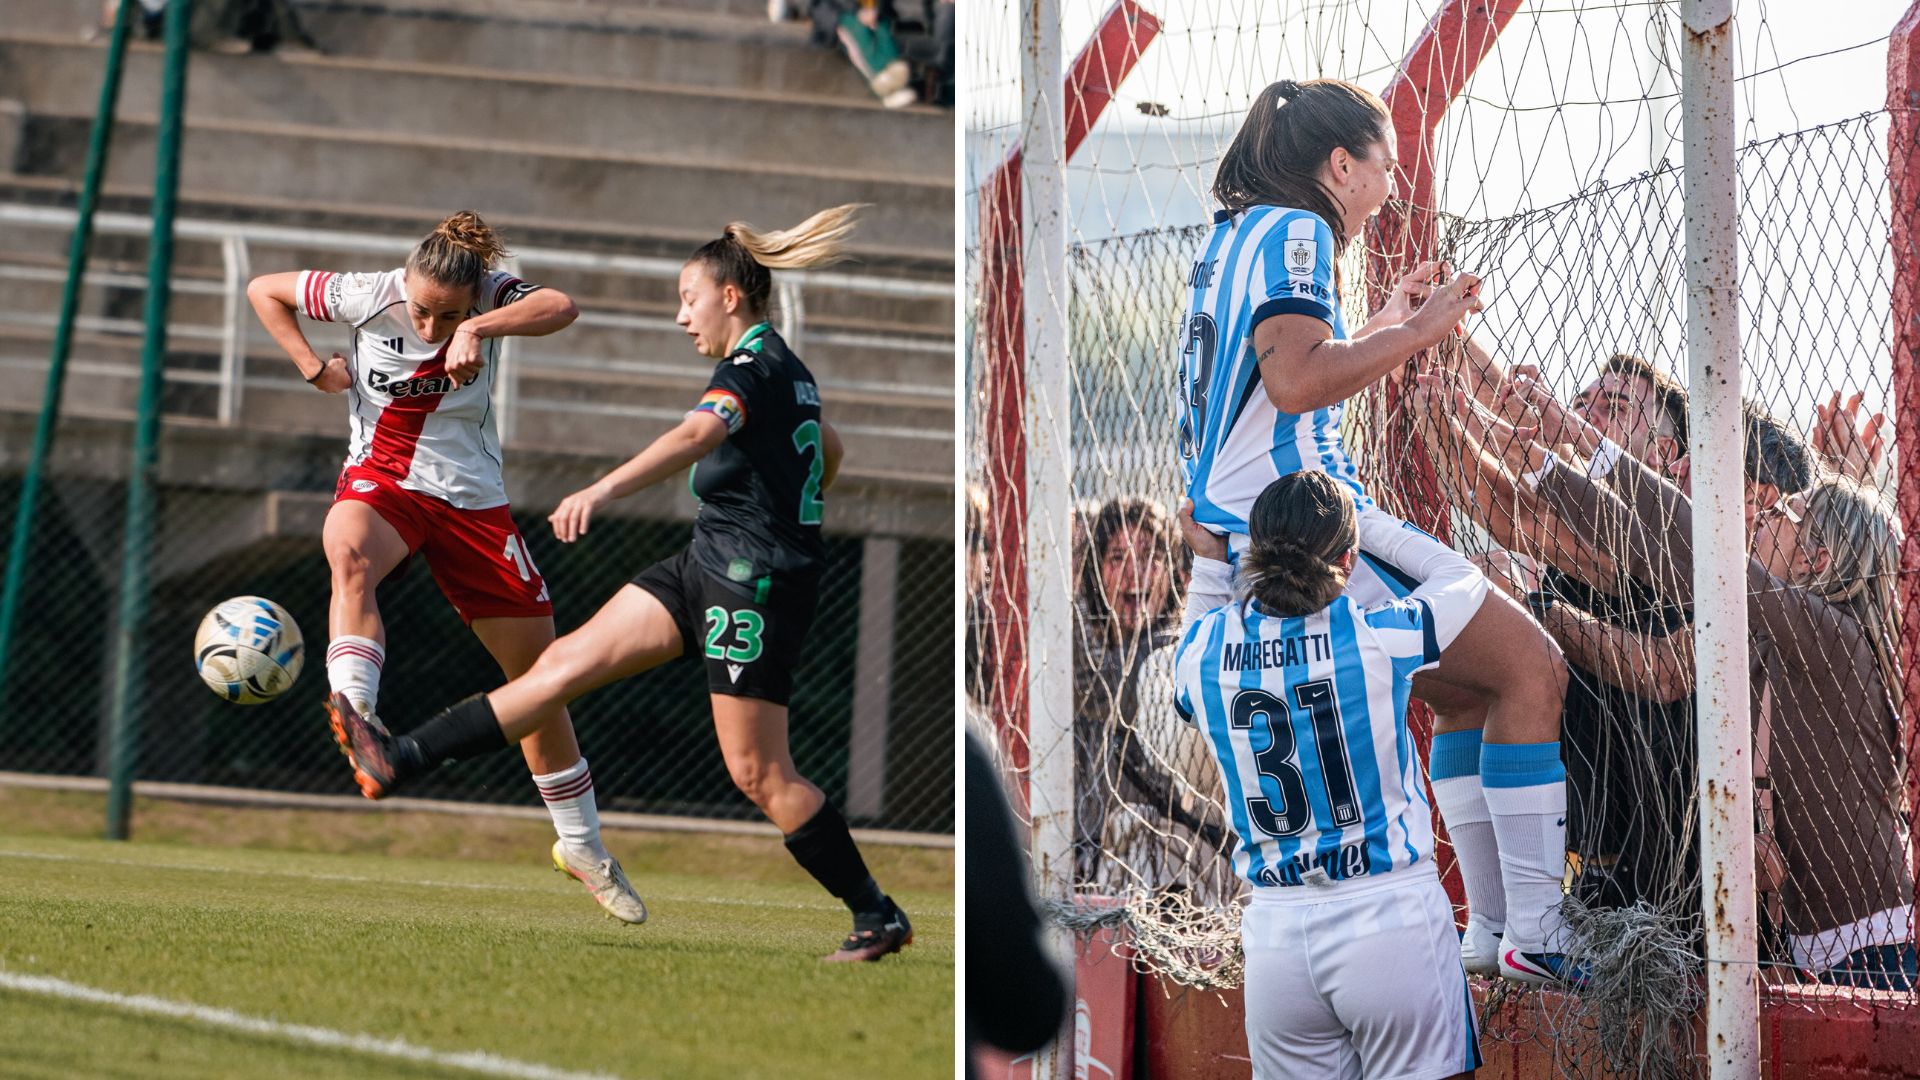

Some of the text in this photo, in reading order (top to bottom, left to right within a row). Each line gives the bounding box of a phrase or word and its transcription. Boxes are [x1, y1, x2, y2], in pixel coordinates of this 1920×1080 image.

[1299, 282, 1328, 300] RUS
[705, 605, 765, 663] 23
[1223, 633, 1332, 672] MAREGATTI
[1230, 678, 1361, 837] 31
